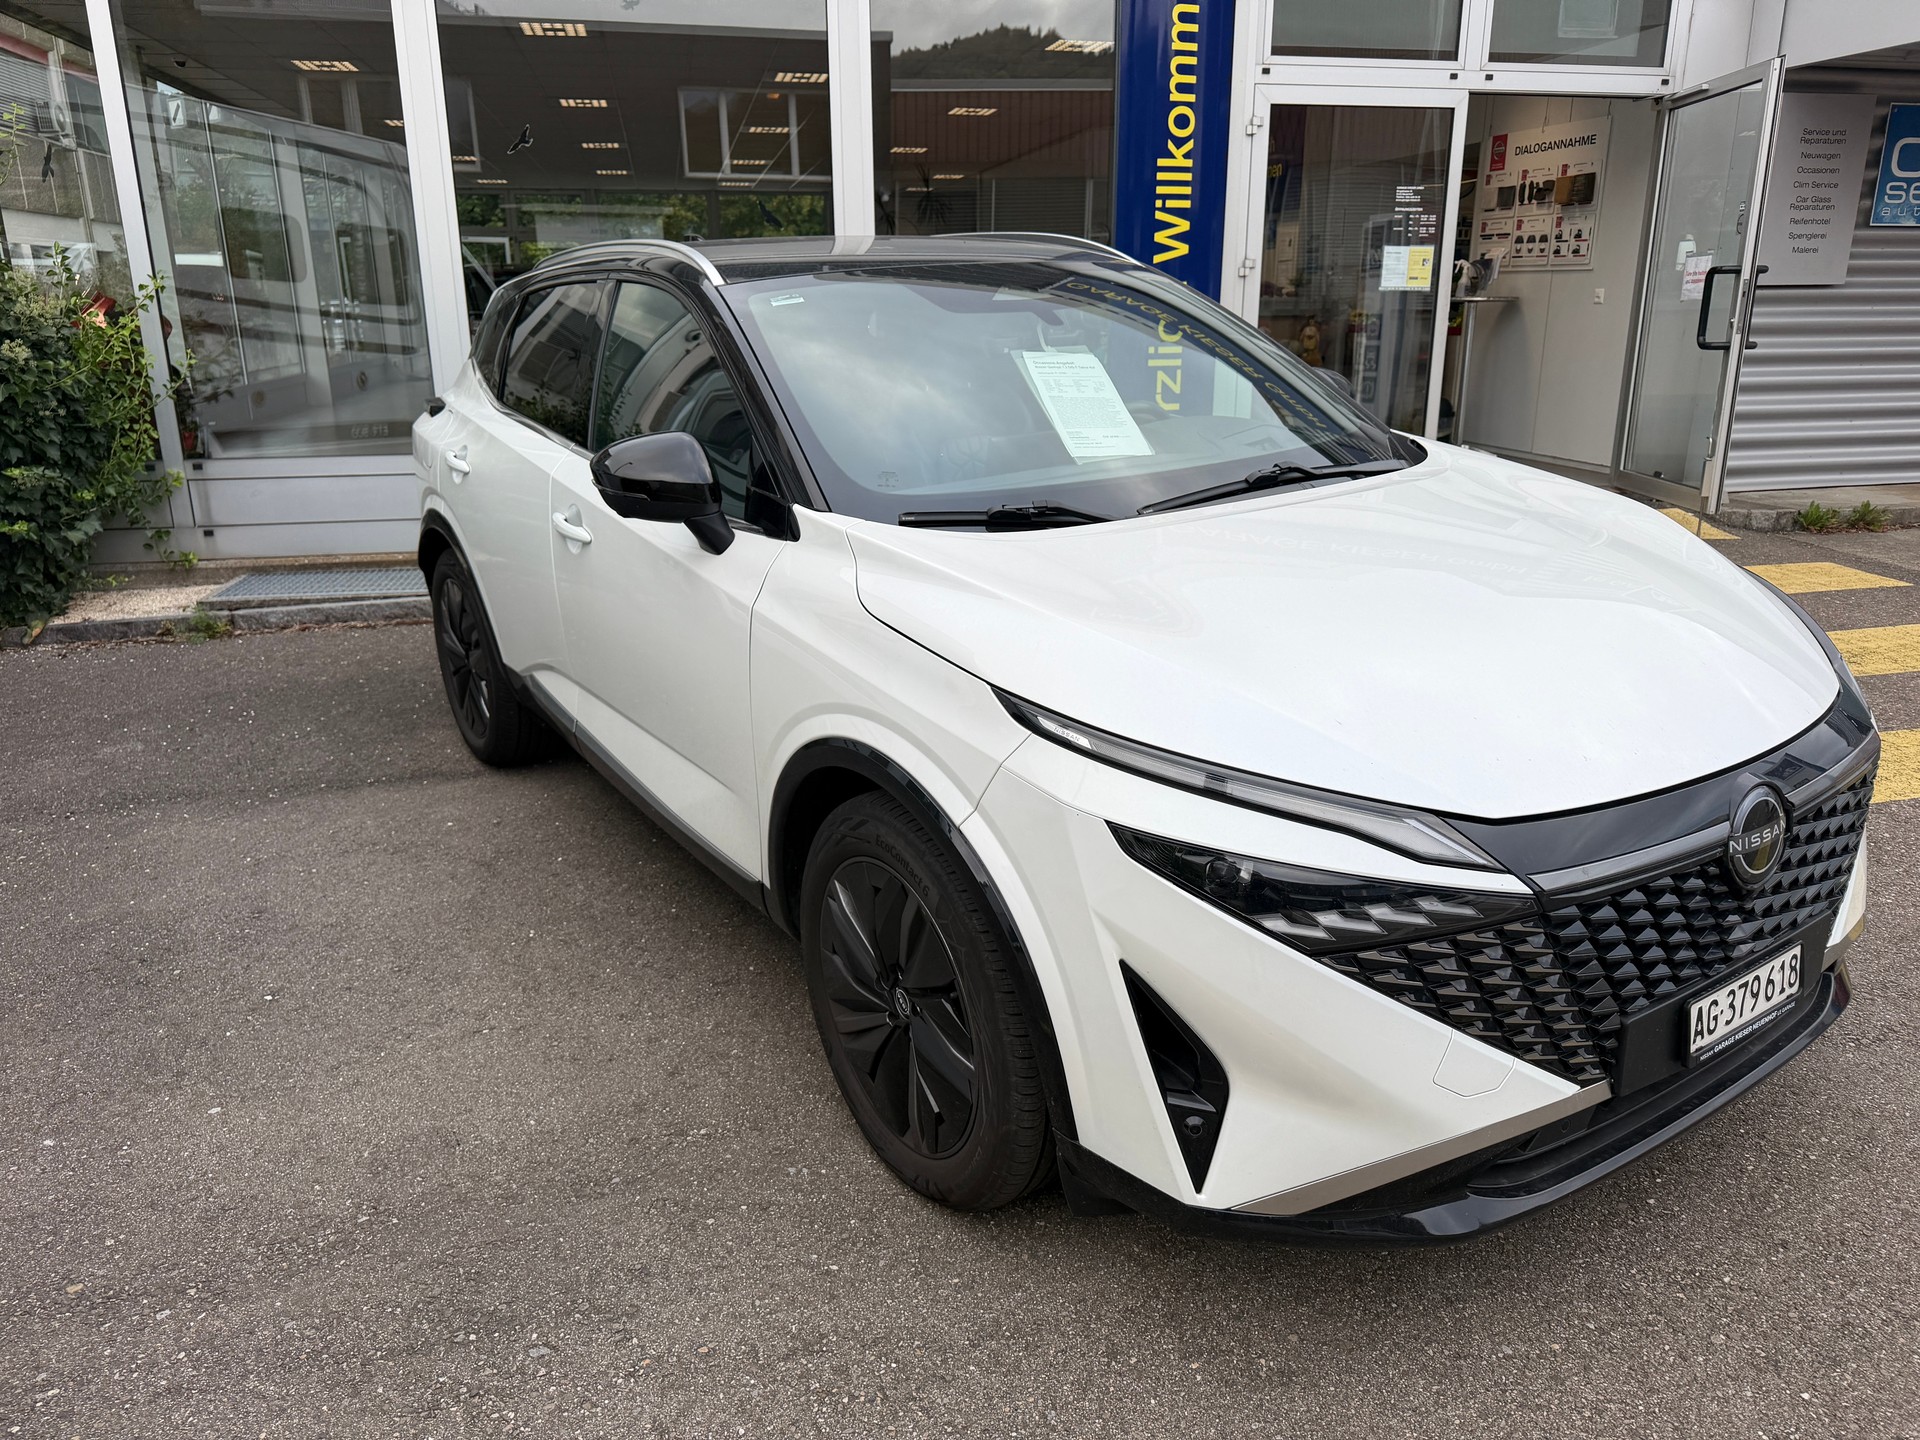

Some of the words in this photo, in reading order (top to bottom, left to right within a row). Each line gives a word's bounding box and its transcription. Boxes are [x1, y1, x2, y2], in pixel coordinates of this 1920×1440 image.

[1153, 3, 1200, 264] Willkomm
[1802, 127, 1830, 136] Service
[1514, 133, 1597, 156] DIALOGANNAHME
[1800, 136, 1847, 146] Reparaturen
[1800, 151, 1841, 161] Neuwagen
[1796, 166, 1840, 174] Occasionen
[1793, 180, 1810, 189] Clim
[1811, 180, 1839, 189] Service
[1795, 195, 1809, 203] Car
[1811, 195, 1832, 203] Glass
[1789, 203, 1836, 211] Reparaturen
[1789, 217, 1832, 225] Reifenhotel
[1788, 231, 1828, 241] Spenglerei
[1791, 246, 1819, 254] Malerei
[1054, 727, 1081, 742] NISSAN
[1729, 819, 1786, 853] NISSAN
[875, 834, 923, 886] EcoContact
[922, 885, 930, 897] 6
[1714, 1036, 1735, 1053] GARAGE
[1735, 1025, 1753, 1041] KIESER
[1752, 1010, 1778, 1031] NEUENHOF
